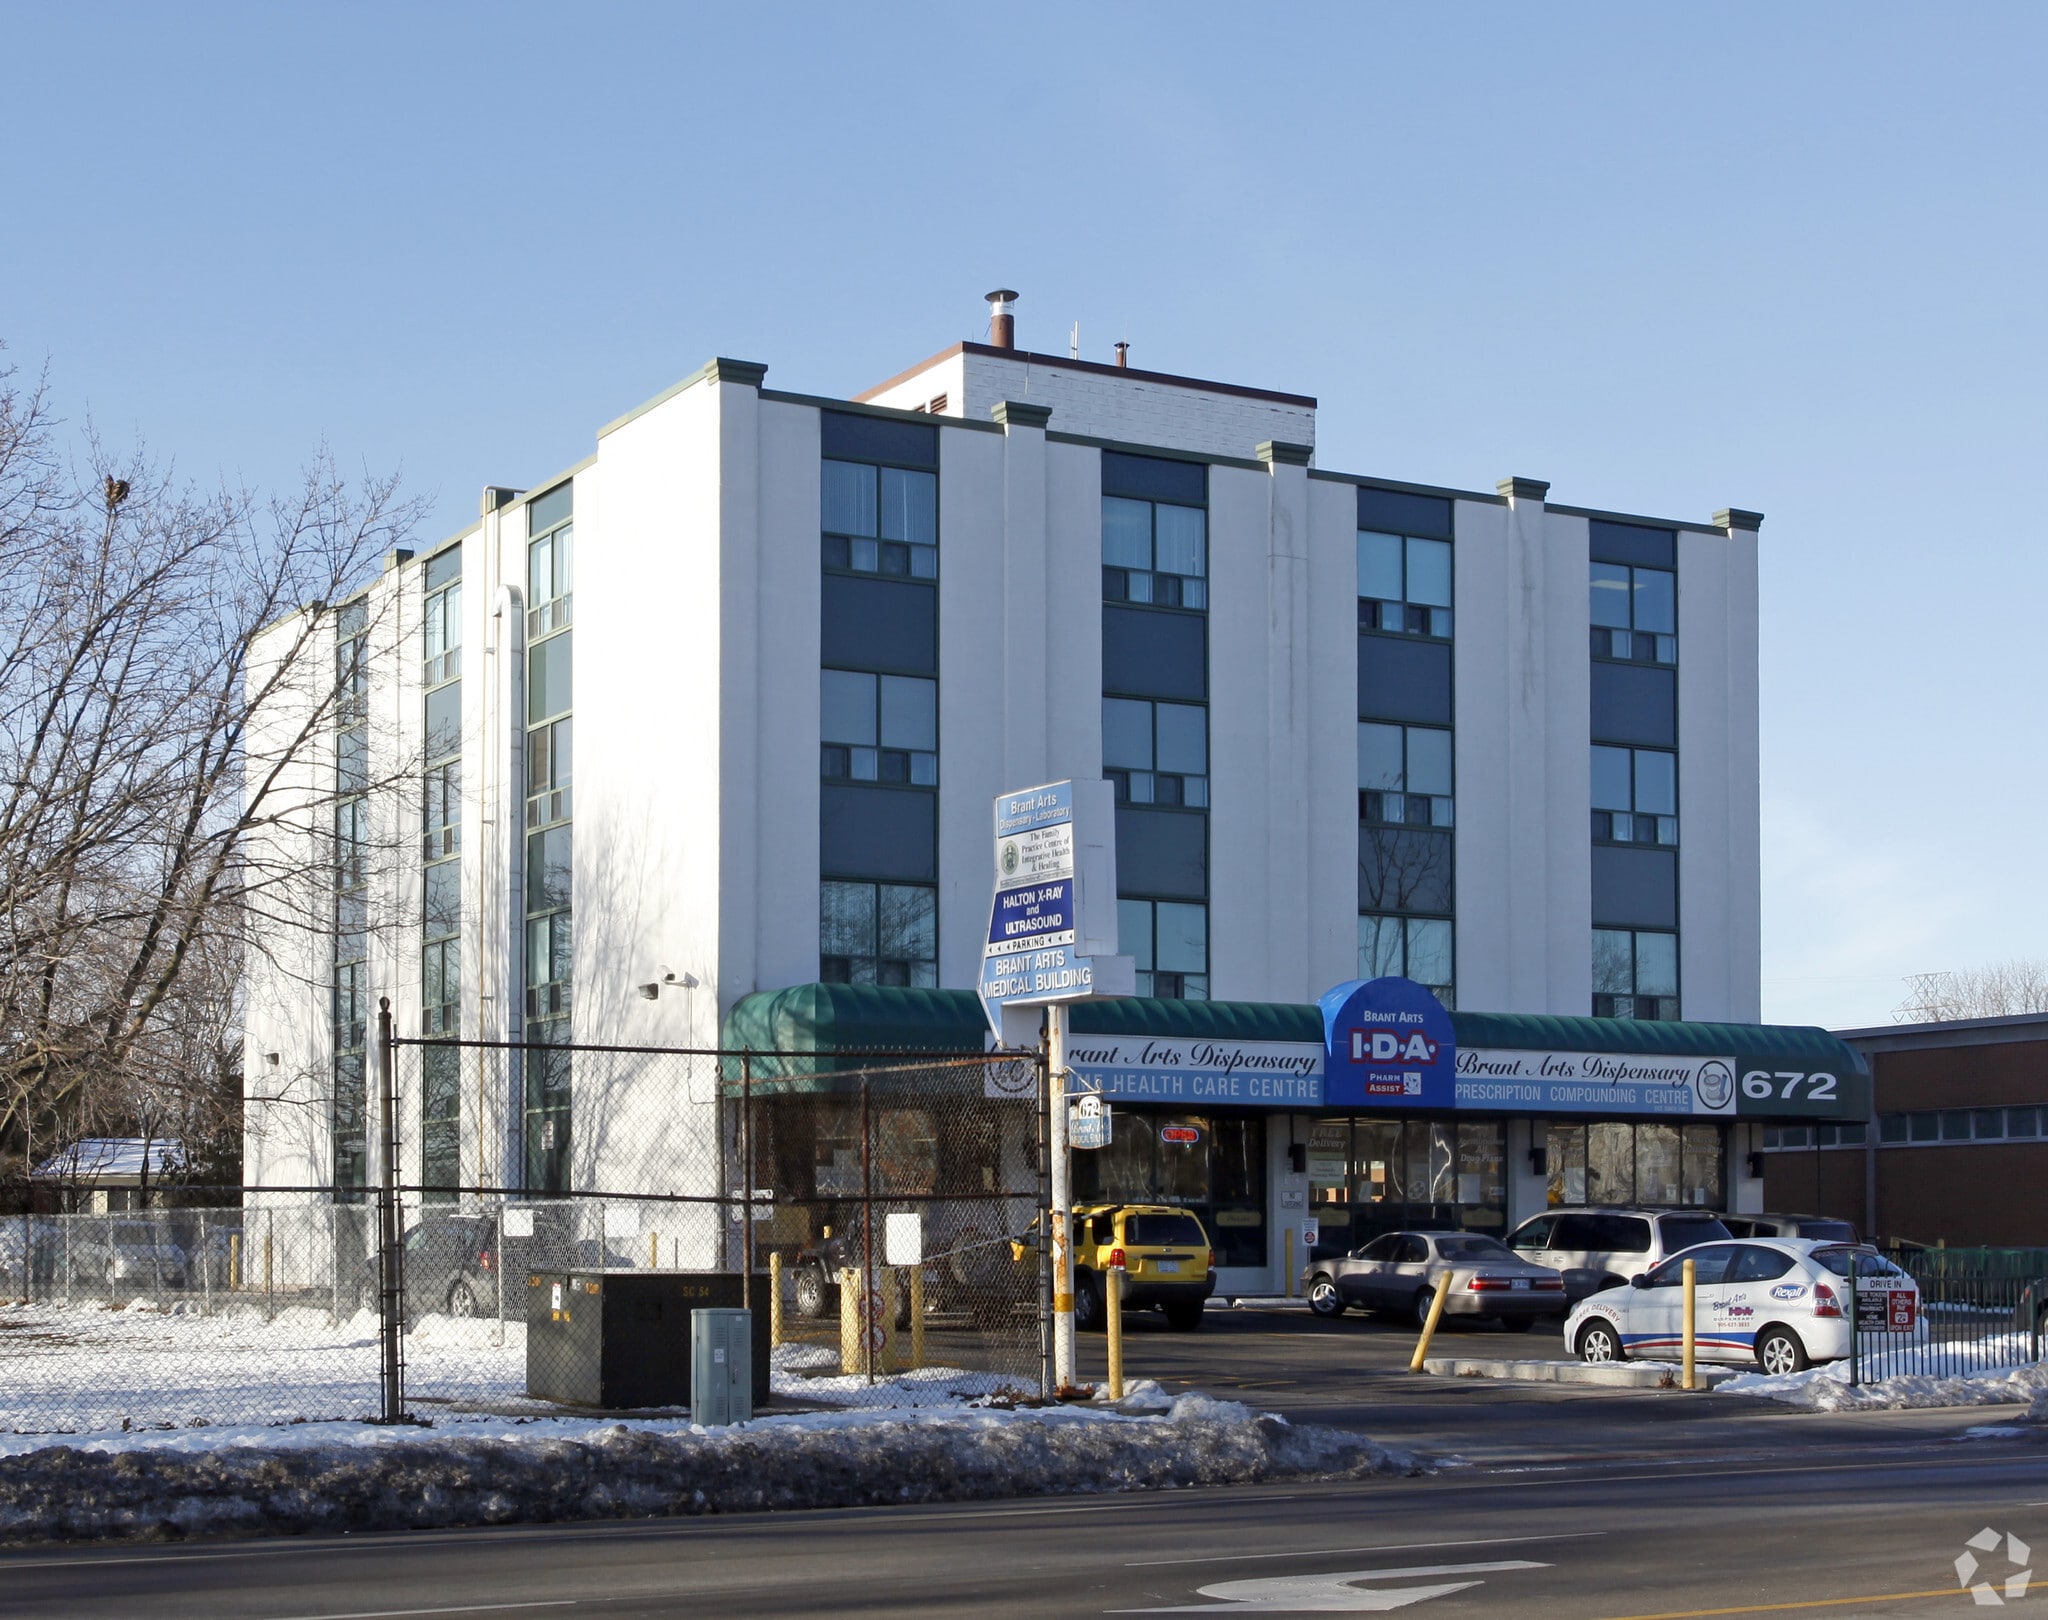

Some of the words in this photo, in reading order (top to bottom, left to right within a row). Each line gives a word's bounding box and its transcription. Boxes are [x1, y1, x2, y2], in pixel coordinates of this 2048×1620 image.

[1010, 797, 1034, 815] Brant
[1037, 793, 1057, 808] Arts
[1003, 891, 1035, 909] HALTON
[1038, 885, 1064, 902] X-RAY
[1026, 904, 1040, 916] and
[1005, 913, 1063, 935] ULTRASOUND
[1012, 936, 1045, 951] PARKING
[995, 955, 1032, 976] BRANT
[1034, 949, 1066, 970] ARTS
[984, 975, 1033, 999] MEDICAL
[1036, 966, 1092, 992] BUILDING
[1069, 1047, 1119, 1064] rant
[1124, 1041, 1181, 1067] Arts
[1189, 1043, 1317, 1078] Dispensary
[1456, 1051, 1521, 1075] Brant
[1525, 1054, 1575, 1077] Arts
[1581, 1055, 1691, 1088] Dispensary
[1113, 1074, 1183, 1095] HEALTH
[1193, 1076, 1240, 1096] CARE
[1250, 1078, 1318, 1098] CENTRE
[1456, 1083, 1541, 1100] PRESCRIPTION
[1550, 1086, 1636, 1104] COMPOUNDING
[1645, 1089, 1689, 1105] CENTRE
[1742, 1070, 1837, 1100] 672
[1081, 1102, 1099, 1117] 672
[1164, 1129, 1196, 1141] OPEN
[1308, 1138, 1346, 1149] Delivery
[1774, 1286, 1803, 1299] Rexall
[1870, 1280, 1892, 1288] DRIVE
[1894, 1280, 1902, 1288] IN
[1592, 1303, 1621, 1322] DELIVERY
